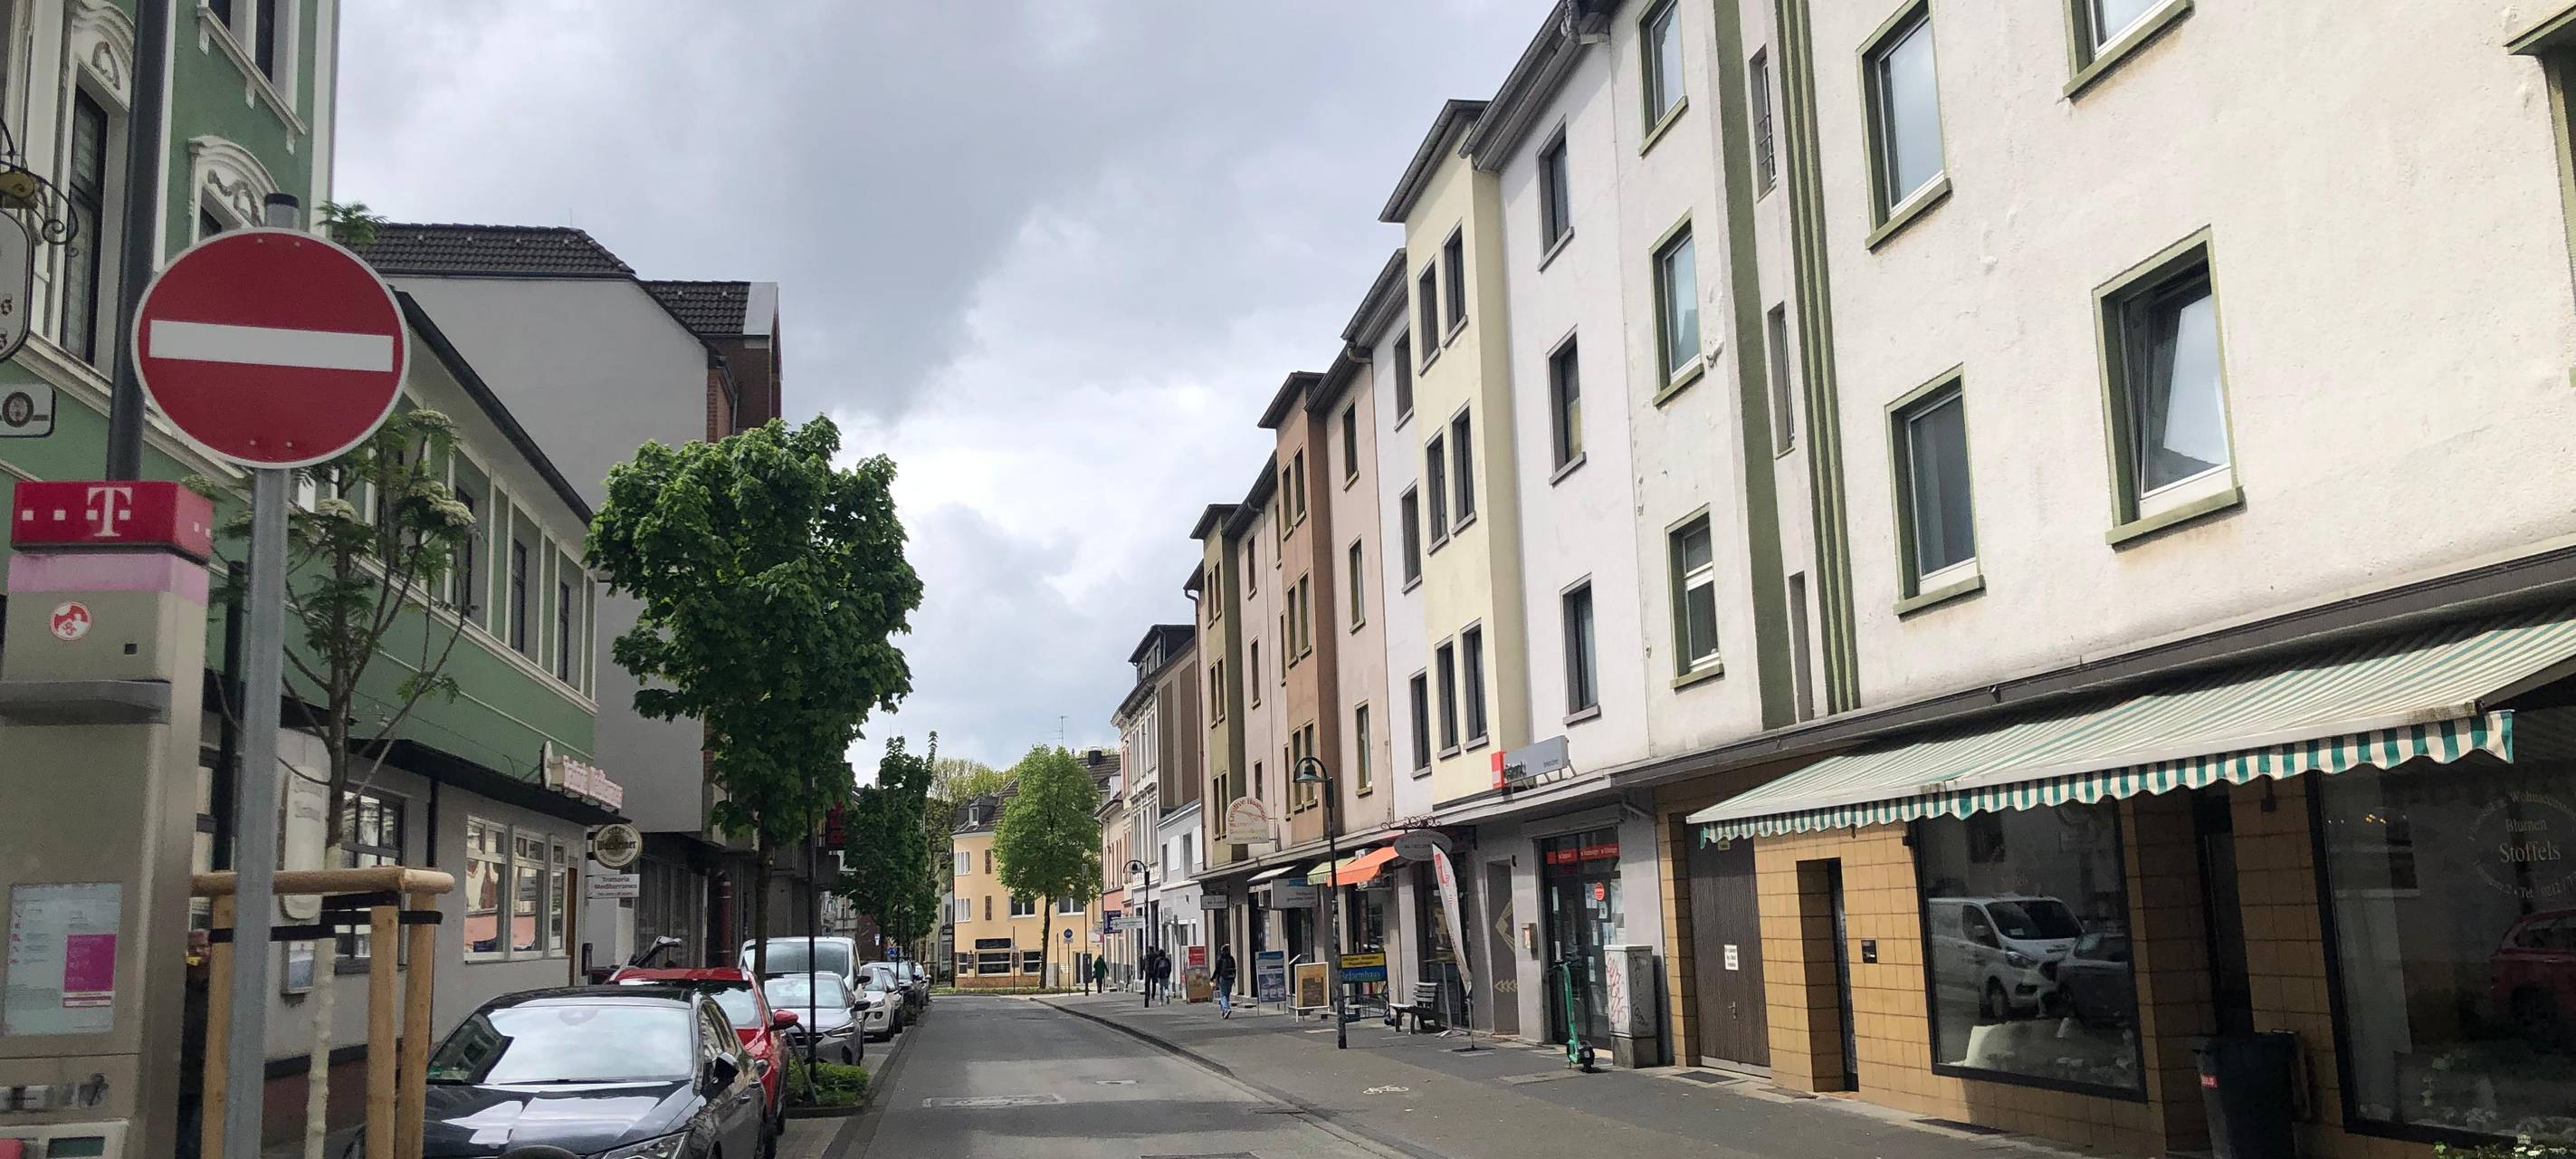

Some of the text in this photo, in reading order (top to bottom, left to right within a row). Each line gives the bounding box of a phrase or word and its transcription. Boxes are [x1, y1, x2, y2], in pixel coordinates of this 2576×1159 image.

[87, 486, 132, 537] T
[2504, 818, 2548, 833] Blumen
[2499, 840, 2562, 863] Stoffels
